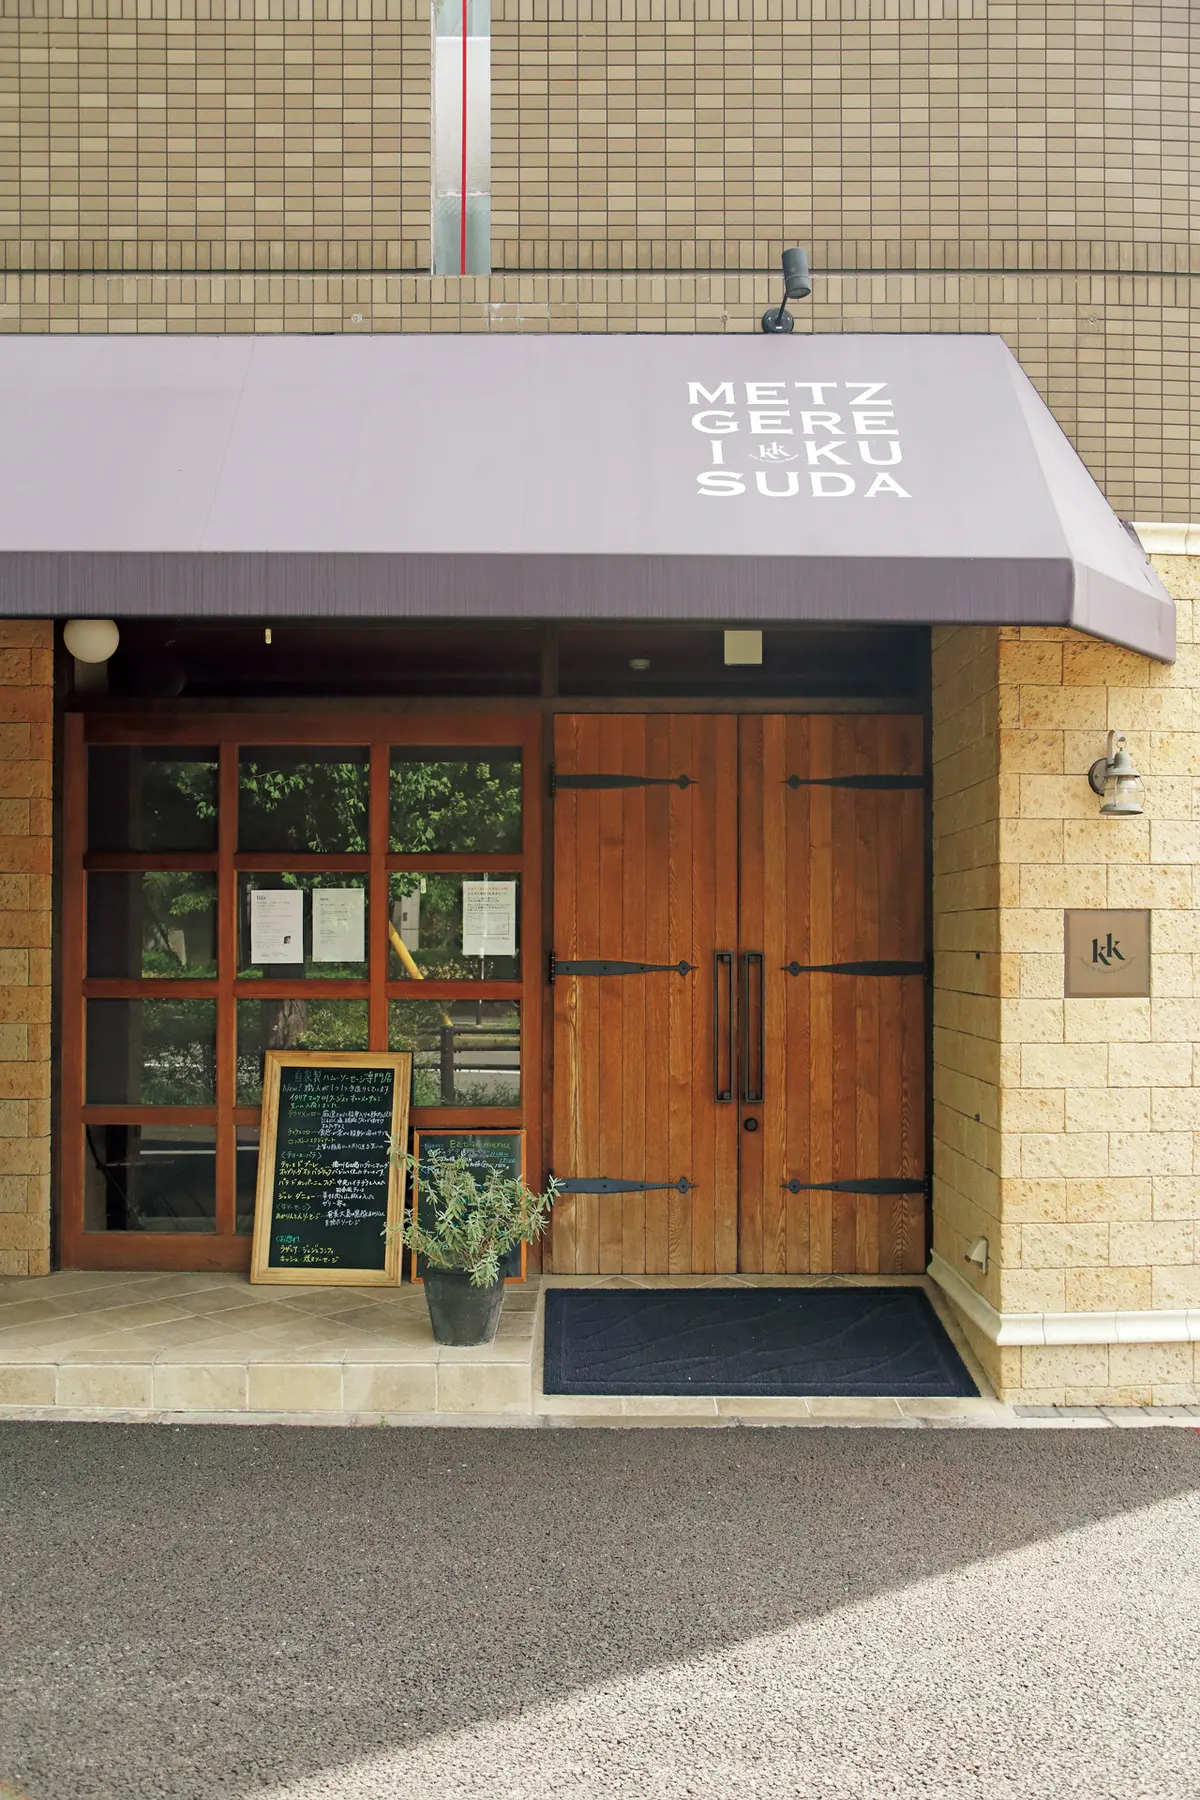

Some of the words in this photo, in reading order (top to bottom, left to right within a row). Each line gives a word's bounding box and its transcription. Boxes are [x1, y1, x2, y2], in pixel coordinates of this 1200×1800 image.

[686, 381, 893, 405] METZ
[691, 410, 899, 435] GERE
[803, 440, 903, 465] KU
[696, 471, 913, 497] SUDA
